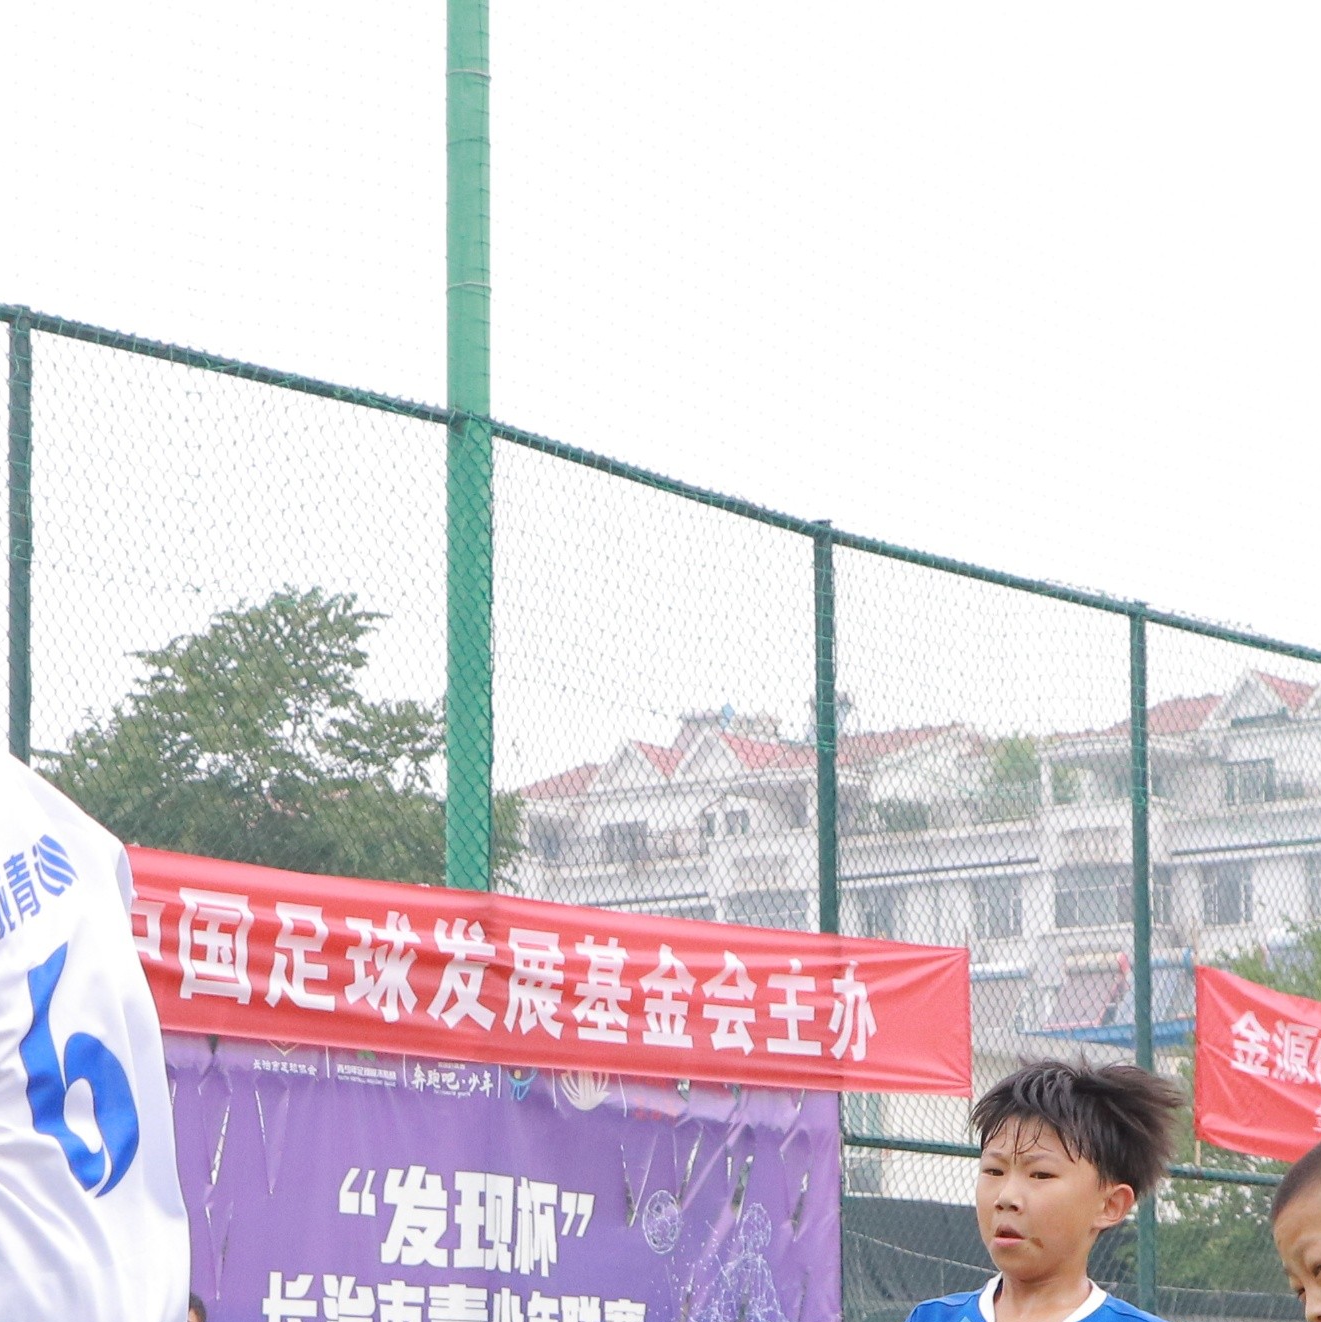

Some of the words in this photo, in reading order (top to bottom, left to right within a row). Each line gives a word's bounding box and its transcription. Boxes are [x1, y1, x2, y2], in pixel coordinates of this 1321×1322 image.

[19, 942, 139, 1198] 6
[338, 1164, 596, 1278] “发现杯”
